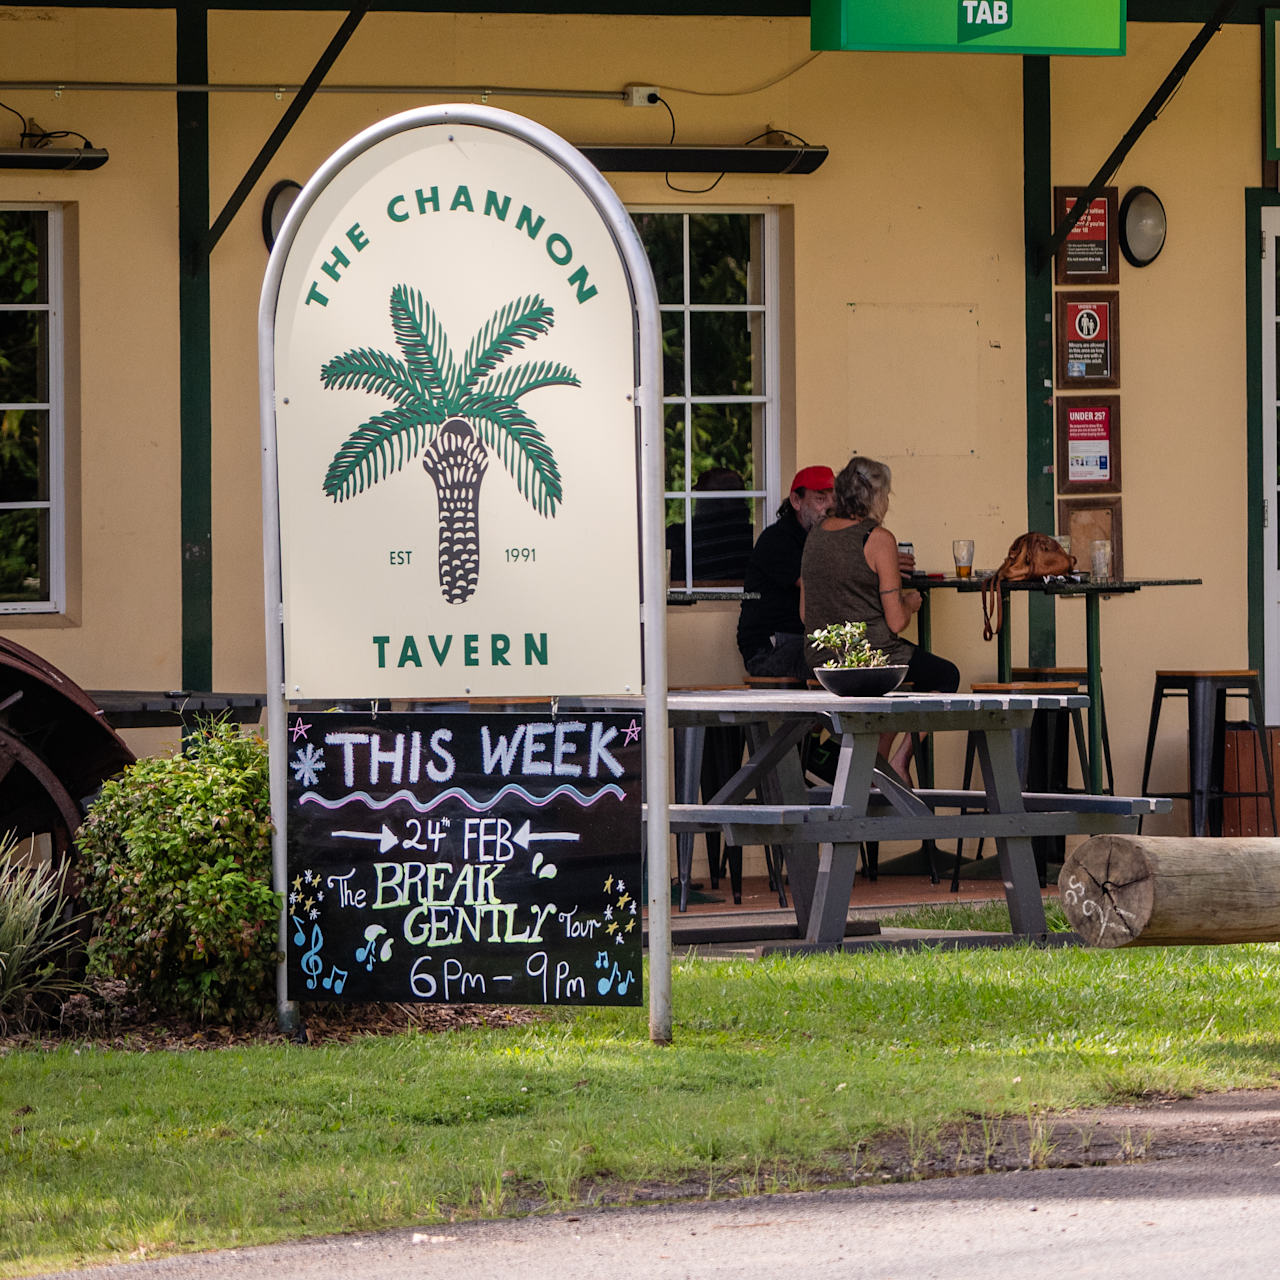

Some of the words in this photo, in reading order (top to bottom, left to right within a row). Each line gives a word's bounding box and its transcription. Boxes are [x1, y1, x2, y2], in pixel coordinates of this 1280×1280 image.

[962, 0, 1008, 25] TAB
[305, 223, 370, 308] THE
[387, 185, 598, 305] CHANNON
[1069, 411, 1093, 421] UNDER
[1094, 411, 1106, 421] 25?
[389, 550, 412, 567] EST
[504, 548, 536, 564] 1991
[373, 632, 548, 669] TAVERN
[325, 728, 455, 787] THIS
[481, 721, 625, 778] WEEK
[464, 817, 515, 862] FEB
[327, 868, 367, 908] The
[372, 862, 506, 910] BREAK
[403, 903, 557, 948] GENTLY
[558, 905, 601, 939] Tour
